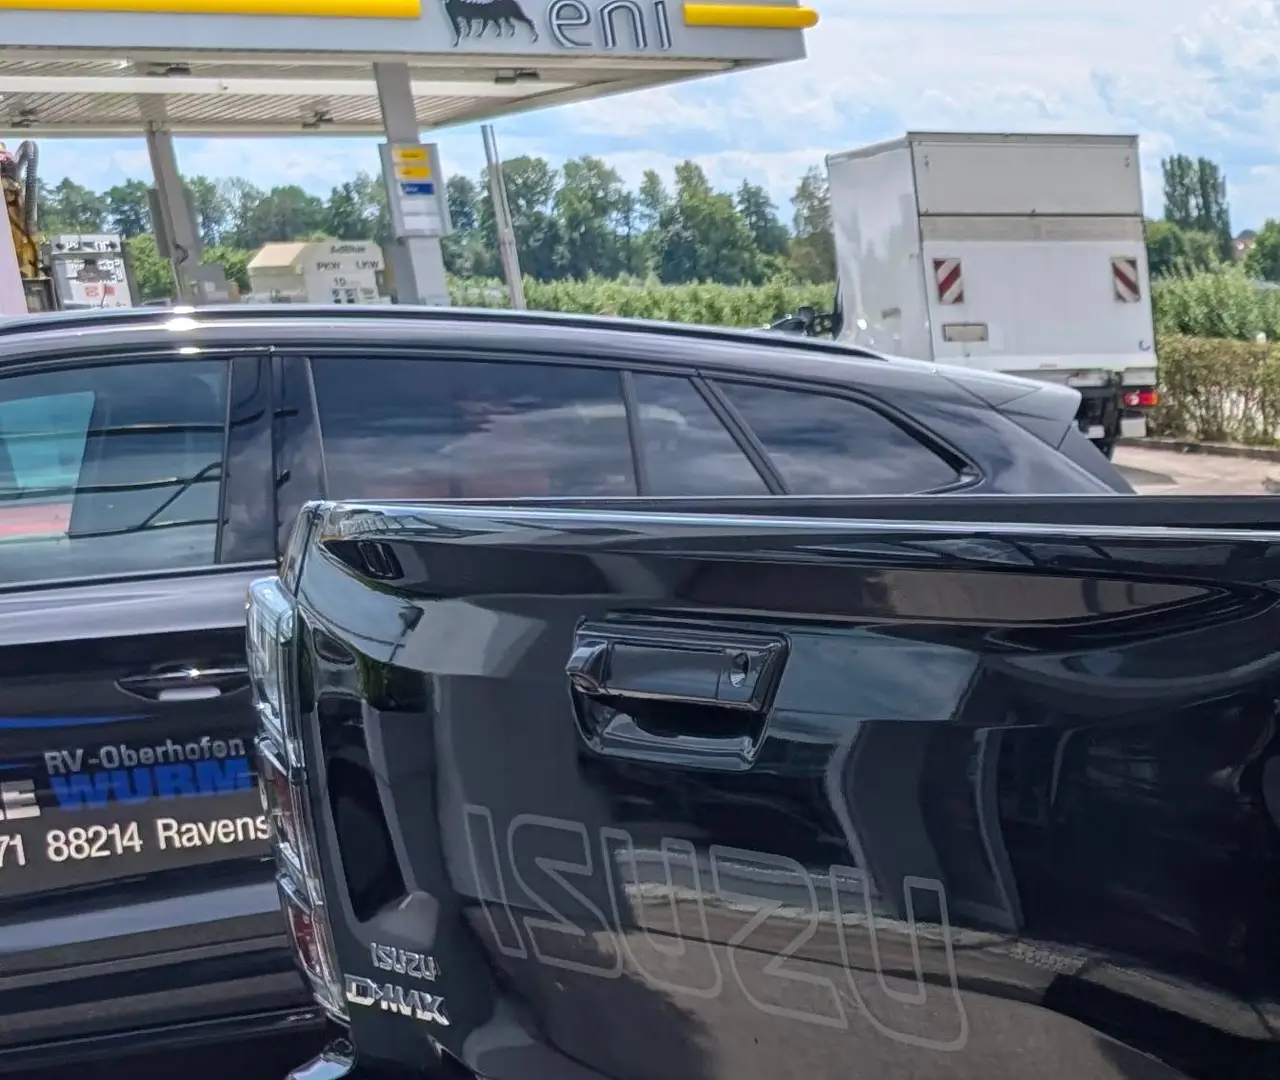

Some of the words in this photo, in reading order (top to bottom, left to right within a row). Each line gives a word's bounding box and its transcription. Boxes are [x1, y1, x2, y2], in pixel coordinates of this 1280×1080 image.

[548, 0, 673, 49] eni
[51, 757, 252, 811] WURM
[46, 821, 144, 863] 88214
[156, 815, 270, 850] Ravens
[462, 804, 969, 1052] ISUZU
[370, 942, 437, 982] ISUZU
